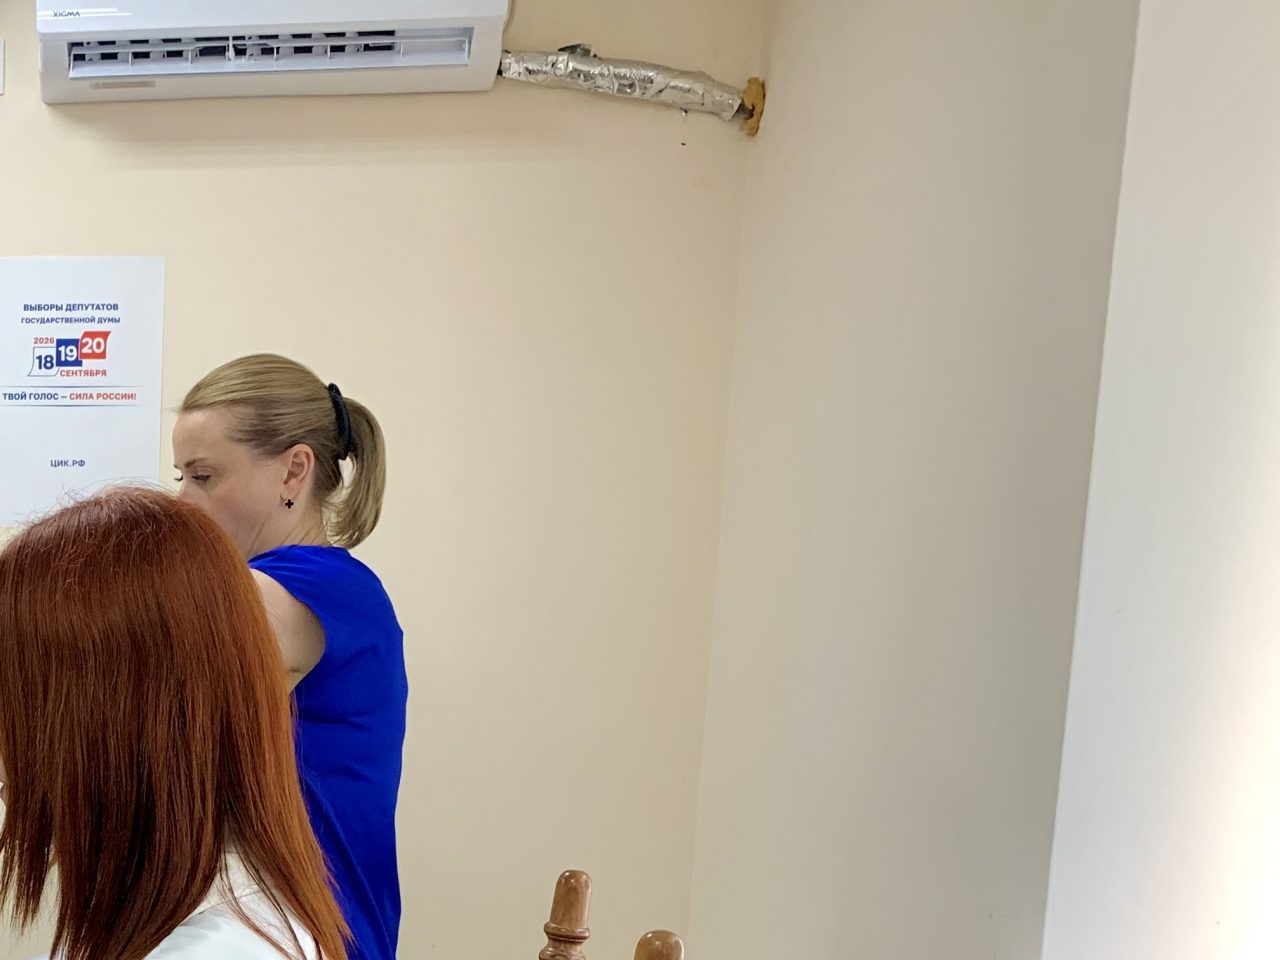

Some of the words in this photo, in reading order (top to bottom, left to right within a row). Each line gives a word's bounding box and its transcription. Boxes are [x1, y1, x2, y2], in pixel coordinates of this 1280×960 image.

[23, 303, 64, 312] ВЫБОРЫ
[65, 303, 119, 313] ДЕПУТАТОВ
[20, 316, 96, 325] ГОСУДАРСТВЕННОЙ
[96, 316, 121, 325] ДУМЫ
[36, 354, 55, 370] 18
[58, 345, 78, 362] 19
[81, 337, 105, 354] 20
[59, 369, 107, 377] СЕНТЯБРЯ
[2, 391, 27, 401] ТВОЙ
[28, 392, 59, 401] ГОЛОС
[69, 392, 95, 401] СИЛА
[96, 392, 137, 401] РОССИИ!
[50, 459, 86, 469] ЦИК.РФ
